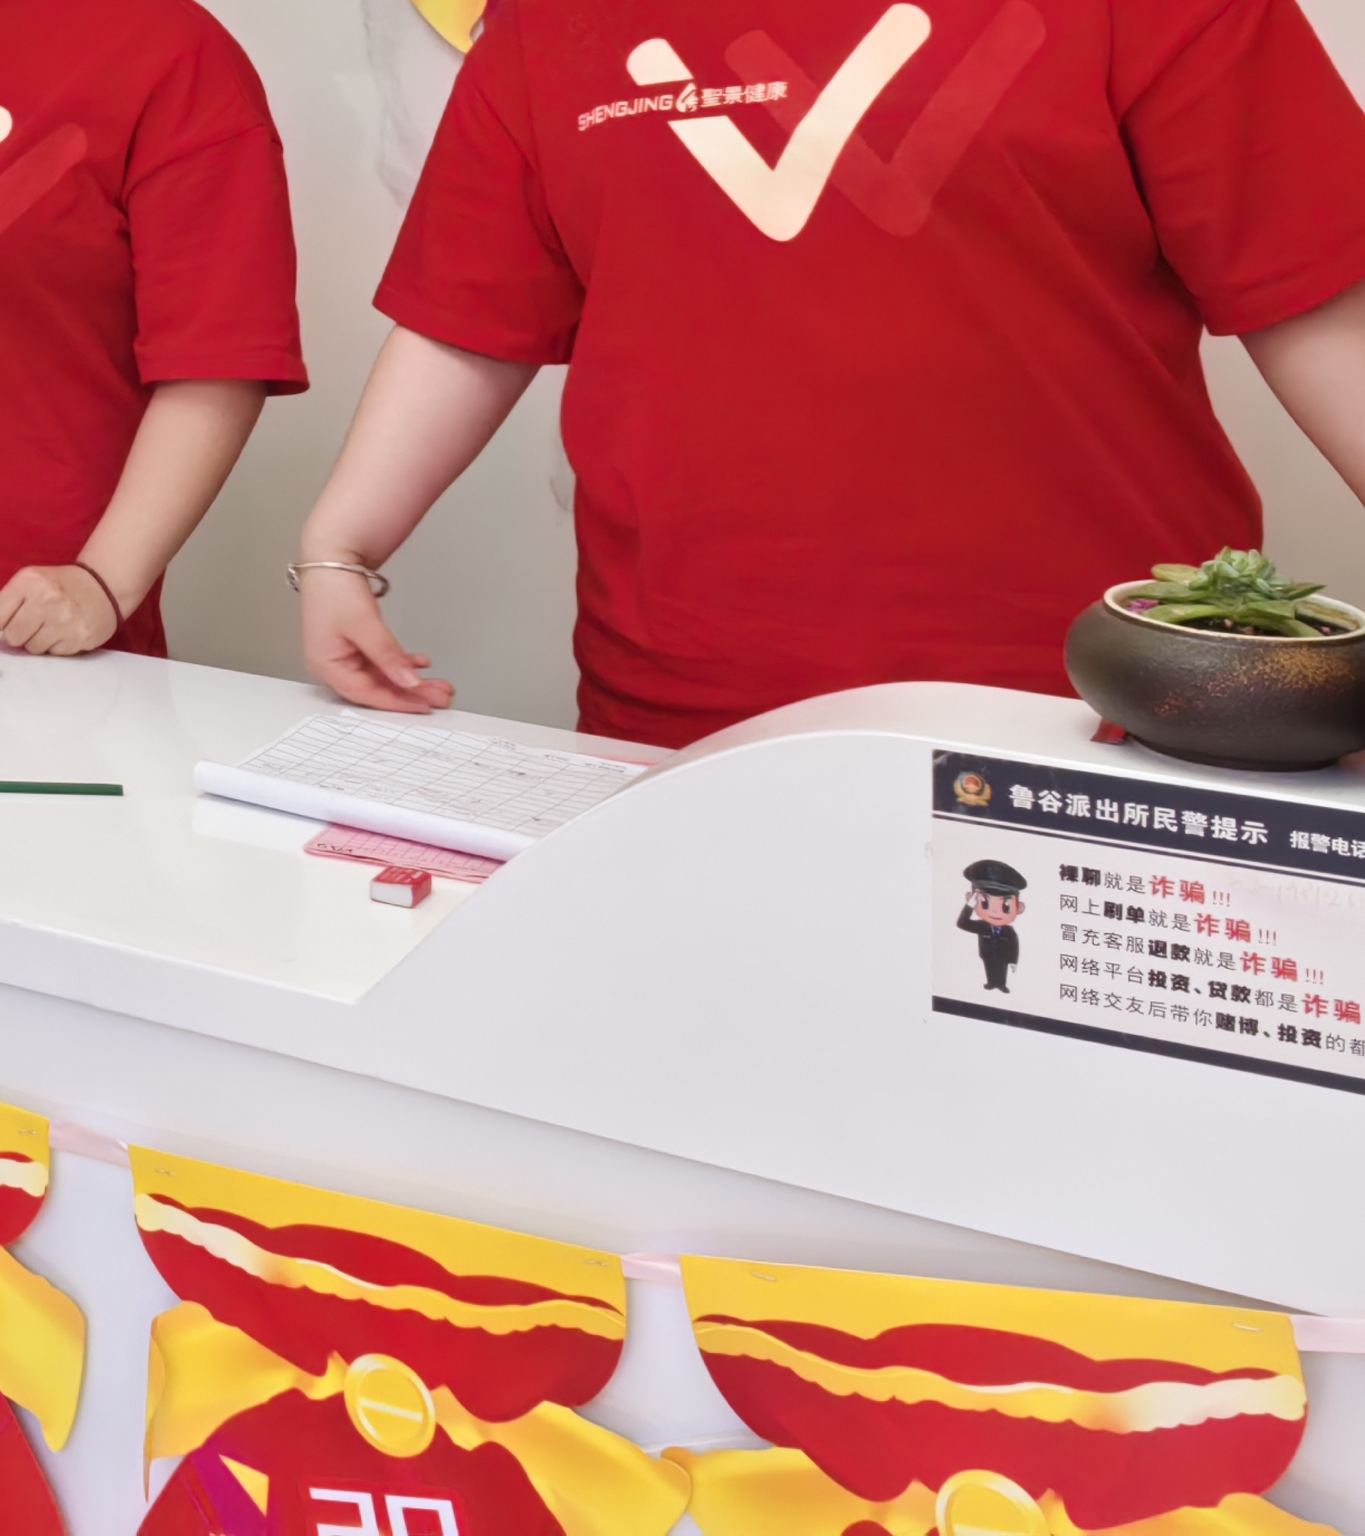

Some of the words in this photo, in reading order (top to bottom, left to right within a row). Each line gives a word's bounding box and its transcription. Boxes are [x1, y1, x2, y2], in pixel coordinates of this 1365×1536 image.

[577, 93, 674, 132] SHENGJING
[699, 81, 789, 108] 聖景健康
[1010, 783, 1268, 844] 鲁谷派出所民警提示
